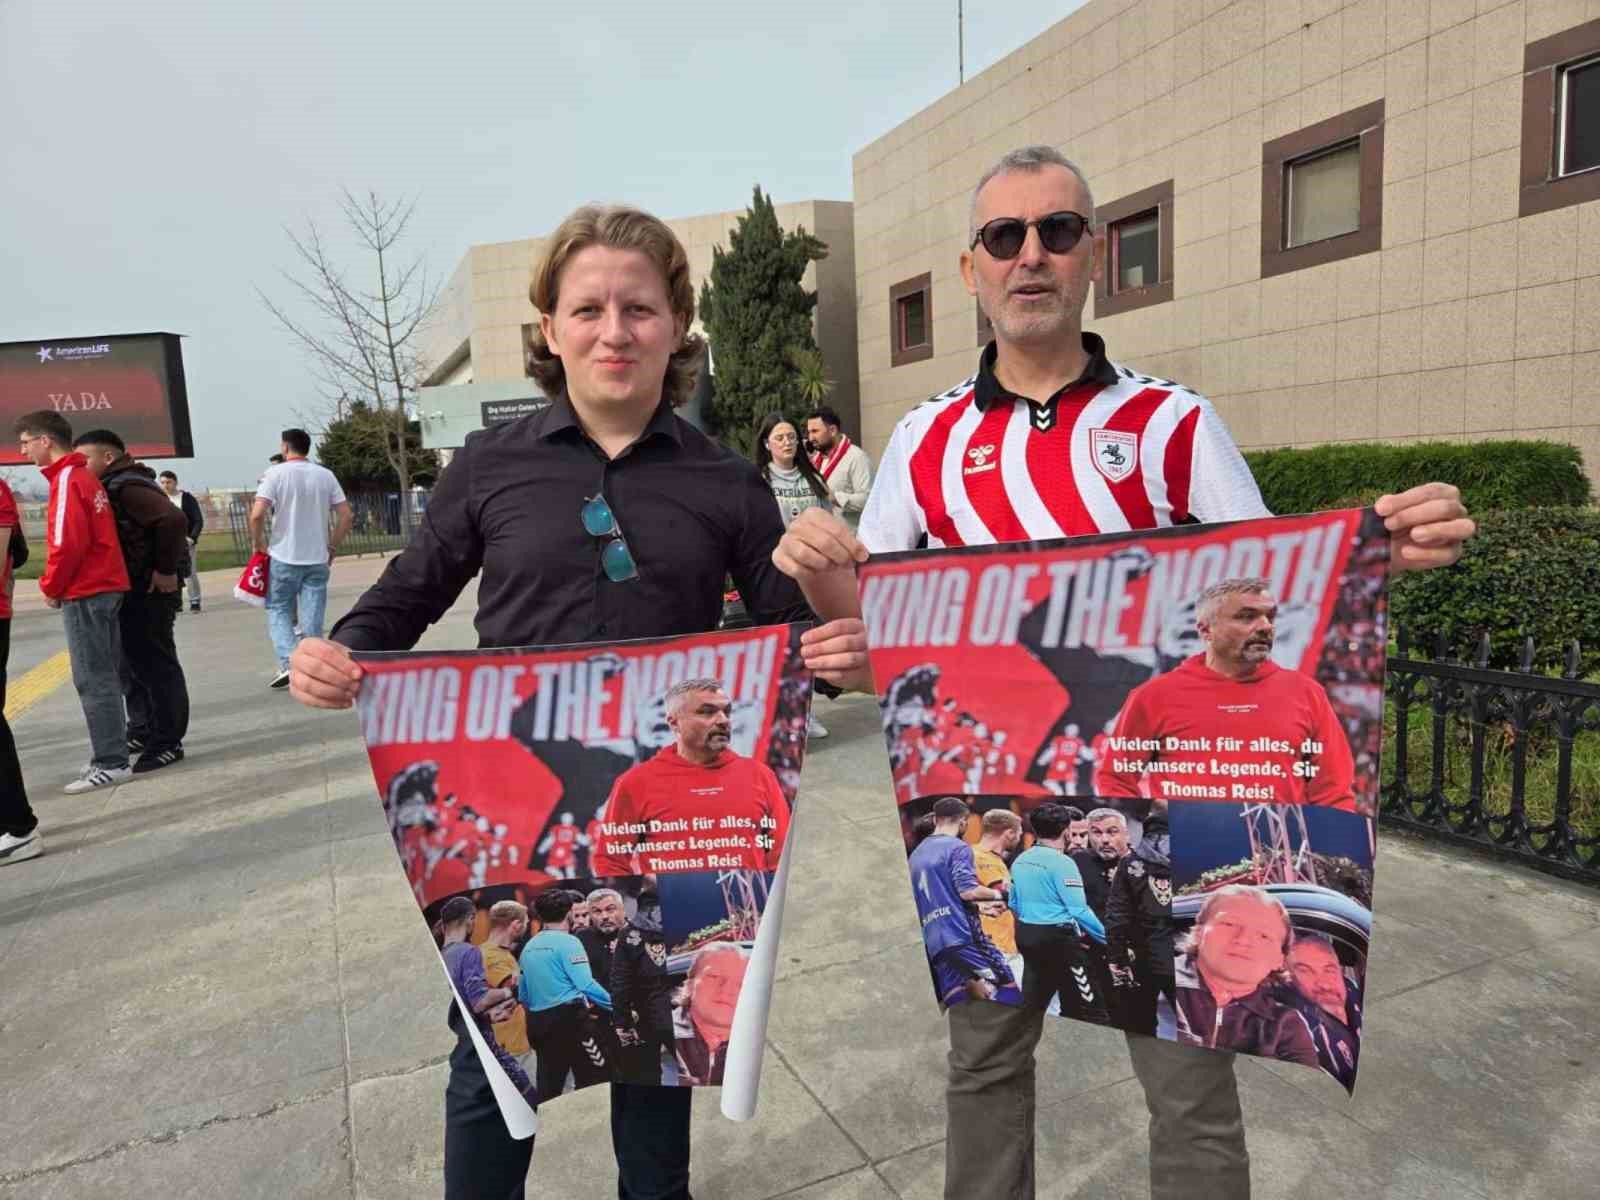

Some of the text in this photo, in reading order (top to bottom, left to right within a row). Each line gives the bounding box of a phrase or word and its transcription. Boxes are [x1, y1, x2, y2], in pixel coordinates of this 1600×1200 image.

[862, 568, 969, 648] KING
[970, 564, 1040, 646] OF
[1041, 557, 1137, 650] THE
[361, 666, 461, 746] KING
[466, 665, 525, 741] OF
[532, 659, 617, 741] THE
[1109, 736, 1323, 755] Vielen Dank für alles, du
[1113, 758, 1320, 778] bist unsere Legende, Sir
[1161, 781, 1275, 799] Thomas Reis!
[602, 815, 777, 836] Vielen Dank für alles, du
[606, 835, 775, 854] bist unsere Legende, Sir
[649, 854, 743, 871] Thomas Reis!
